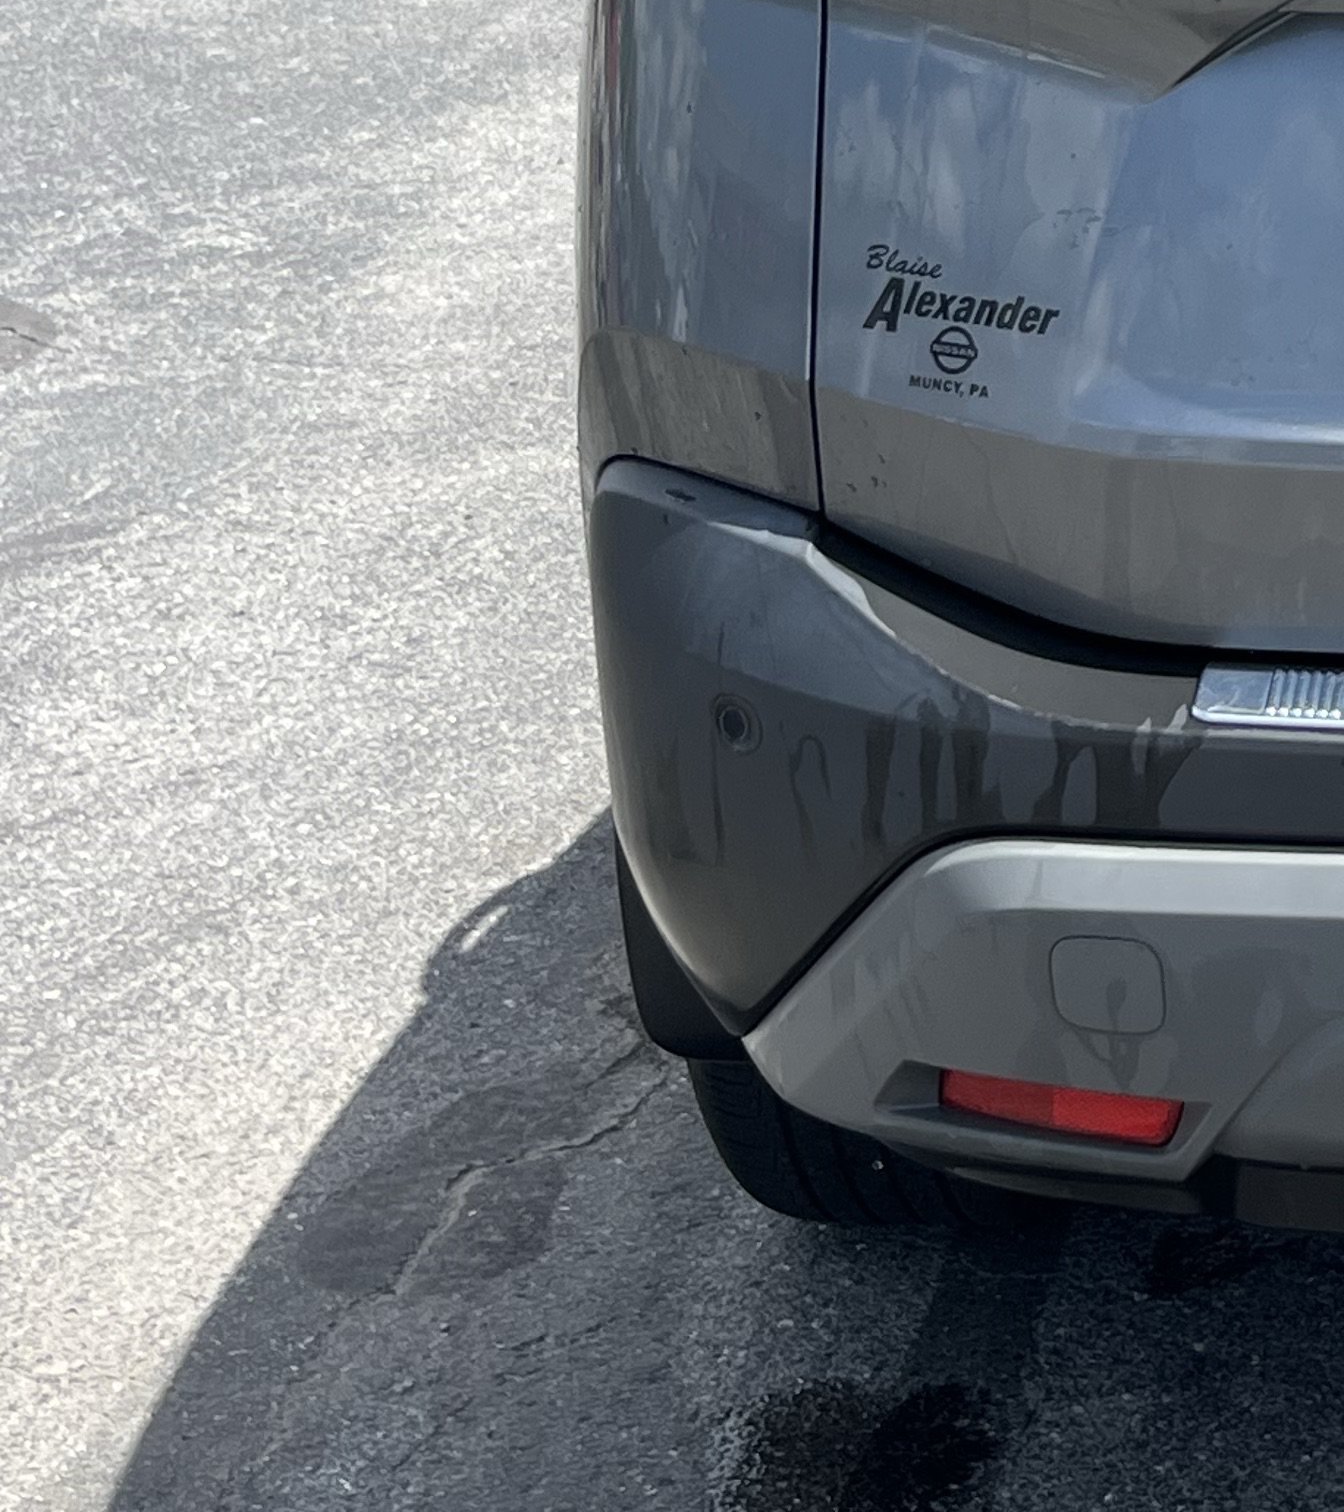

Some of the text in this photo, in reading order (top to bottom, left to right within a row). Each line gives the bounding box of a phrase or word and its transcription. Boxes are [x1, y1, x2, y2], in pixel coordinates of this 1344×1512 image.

[866, 244, 944, 279] Blaise
[862, 276, 1060, 336] Alexander
[909, 375, 990, 399] MUNCY, PA
